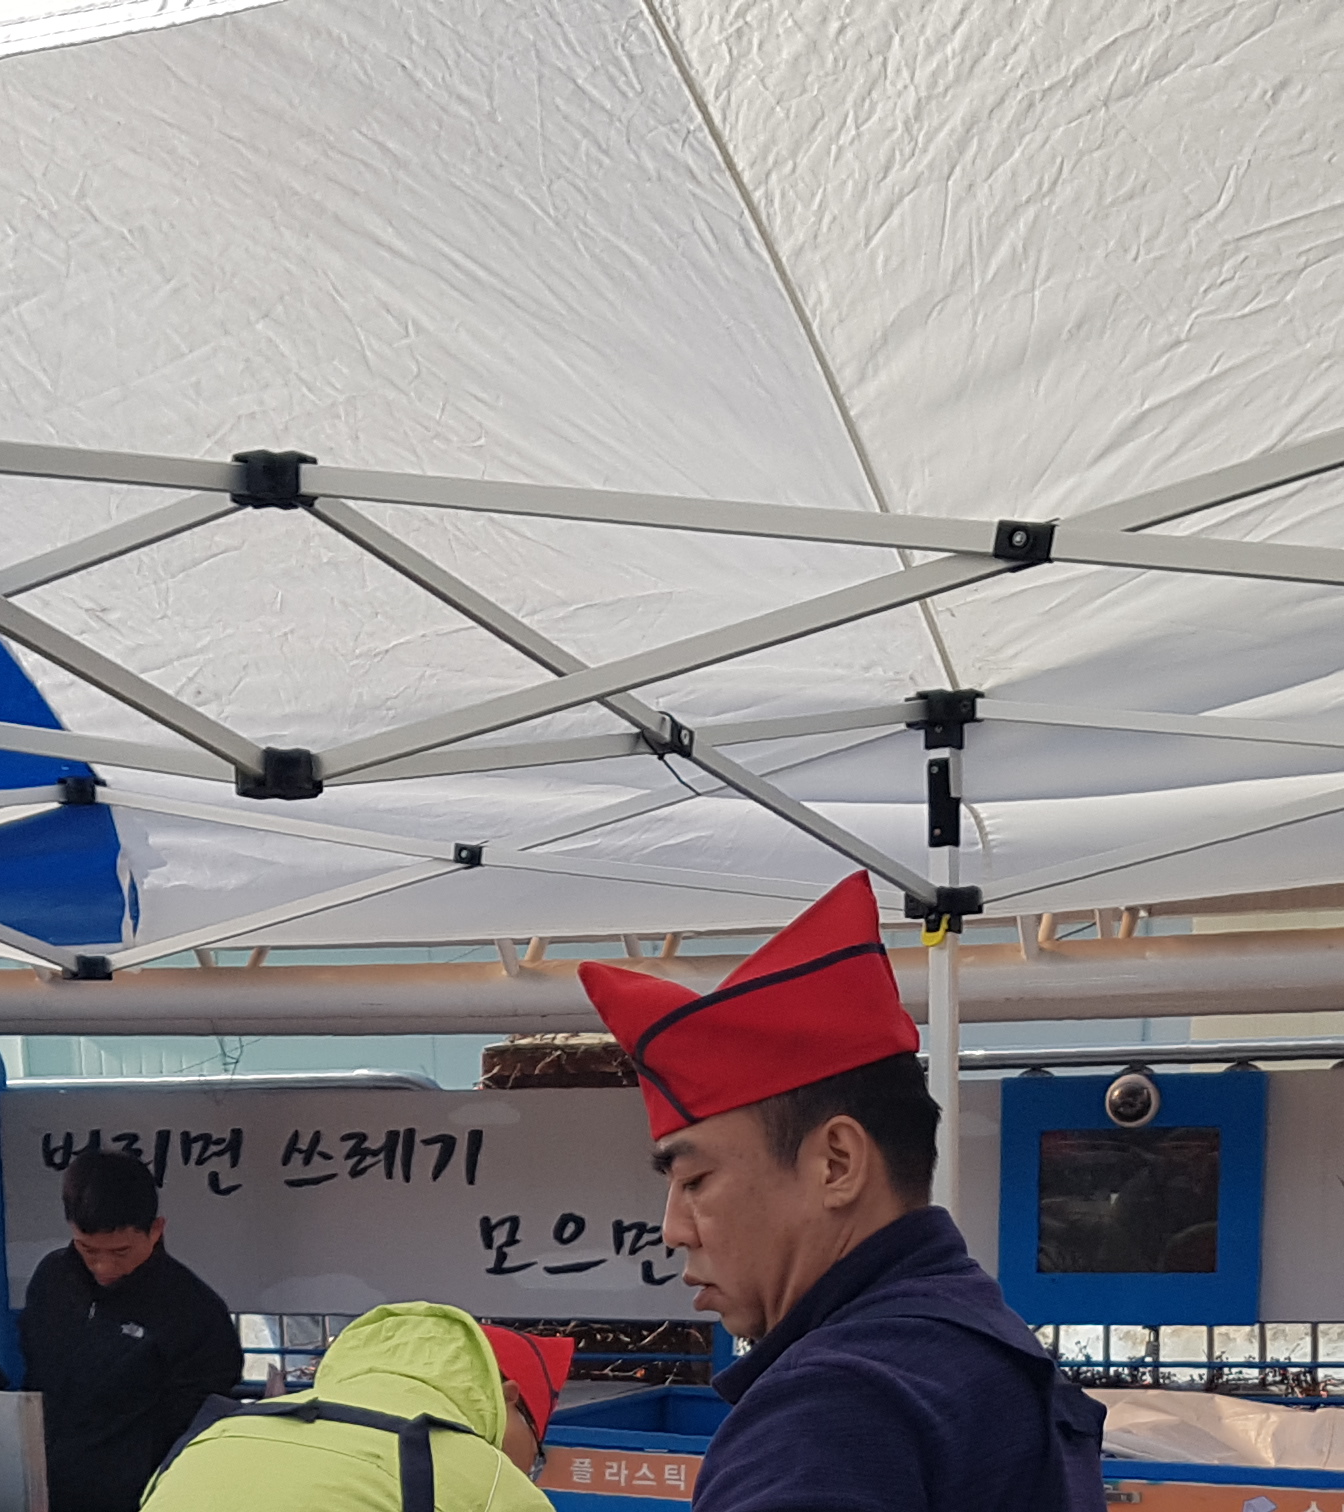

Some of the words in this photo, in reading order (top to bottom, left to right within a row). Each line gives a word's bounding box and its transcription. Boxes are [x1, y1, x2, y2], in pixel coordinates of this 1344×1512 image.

[42, 1127, 244, 1196] 버리면
[282, 1127, 484, 1188] 쓰레기
[479, 1212, 679, 1286] 모으면
[570, 1457, 687, 1491] 플라스틱
